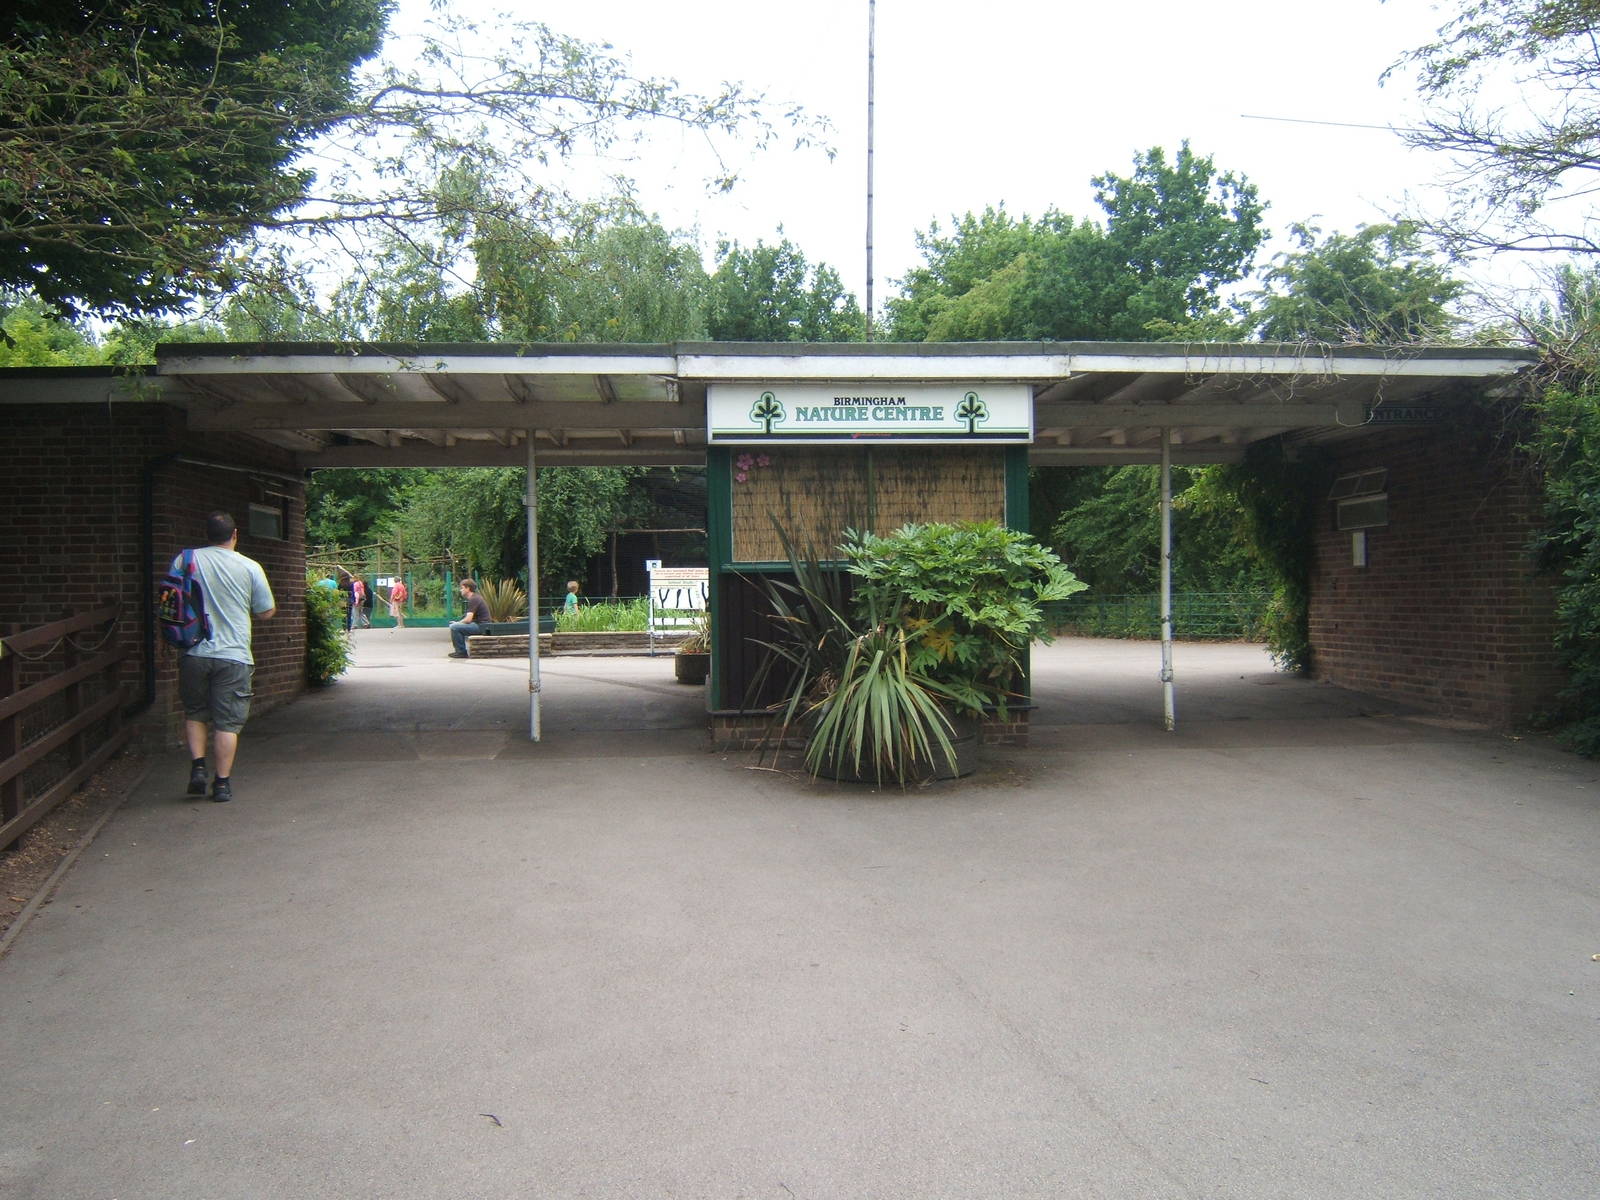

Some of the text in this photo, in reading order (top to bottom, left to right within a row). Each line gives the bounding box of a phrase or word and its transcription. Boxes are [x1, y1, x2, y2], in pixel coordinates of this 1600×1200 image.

[833, 397, 906, 406] BIRMINGHAM
[795, 406, 944, 421] NATURE CENTRE
